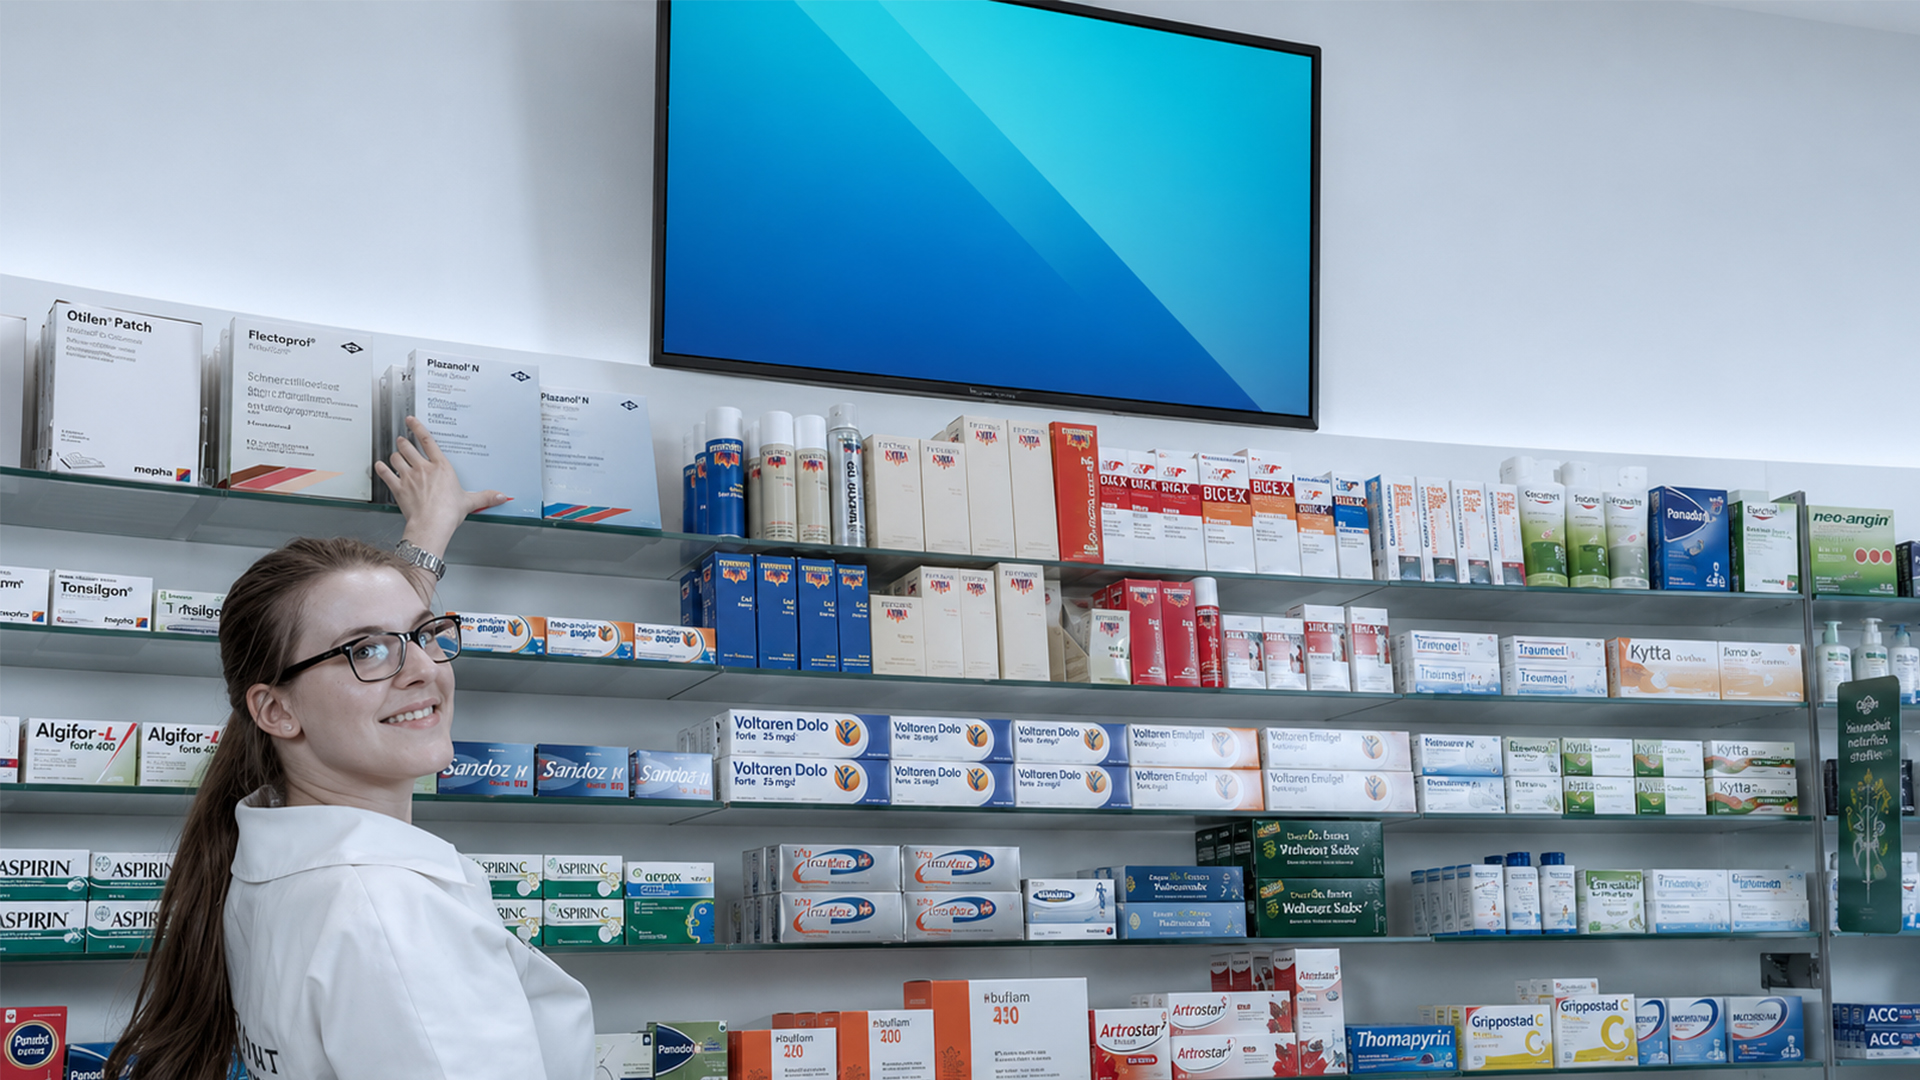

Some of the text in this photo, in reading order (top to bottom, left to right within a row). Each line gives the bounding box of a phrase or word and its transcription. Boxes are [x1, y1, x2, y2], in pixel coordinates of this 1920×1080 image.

[114, 316, 152, 334] Patch
[472, 364, 480, 373] N
[582, 396, 590, 405] N
[134, 465, 173, 478] mepha
[1630, 644, 1671, 664] Kytta
[734, 715, 829, 732] Voltaren Dolo
[894, 721, 961, 735] Voltaren Dolo
[1018, 726, 1080, 738] Voltaren Dolo
[1133, 728, 1171, 739] Voltaren
[95, 741, 116, 752] 400
[1716, 743, 1749, 758] Kytta
[442, 757, 510, 779] Sandoz
[543, 760, 606, 781] Sandoz
[733, 761, 828, 778] Voltaren Dolo
[894, 765, 961, 778] Voltaren Dolo
[1018, 768, 1081, 780] Voltaren Dolo
[1720, 781, 1751, 796] Kytta
[0, 859, 71, 877] ASPIRIN
[1173, 1003, 1222, 1018] Artrostar
[1560, 998, 1629, 1014] Grippostad C
[1472, 1013, 1544, 1030] Grippostad C
[1867, 1007, 1899, 1022] ACC
[1100, 1023, 1161, 1038] Artrostar
[1357, 1030, 1450, 1050] Thomapyrin
[1869, 1032, 1900, 1047] ACC
[1177, 1046, 1226, 1060] Artrostar
